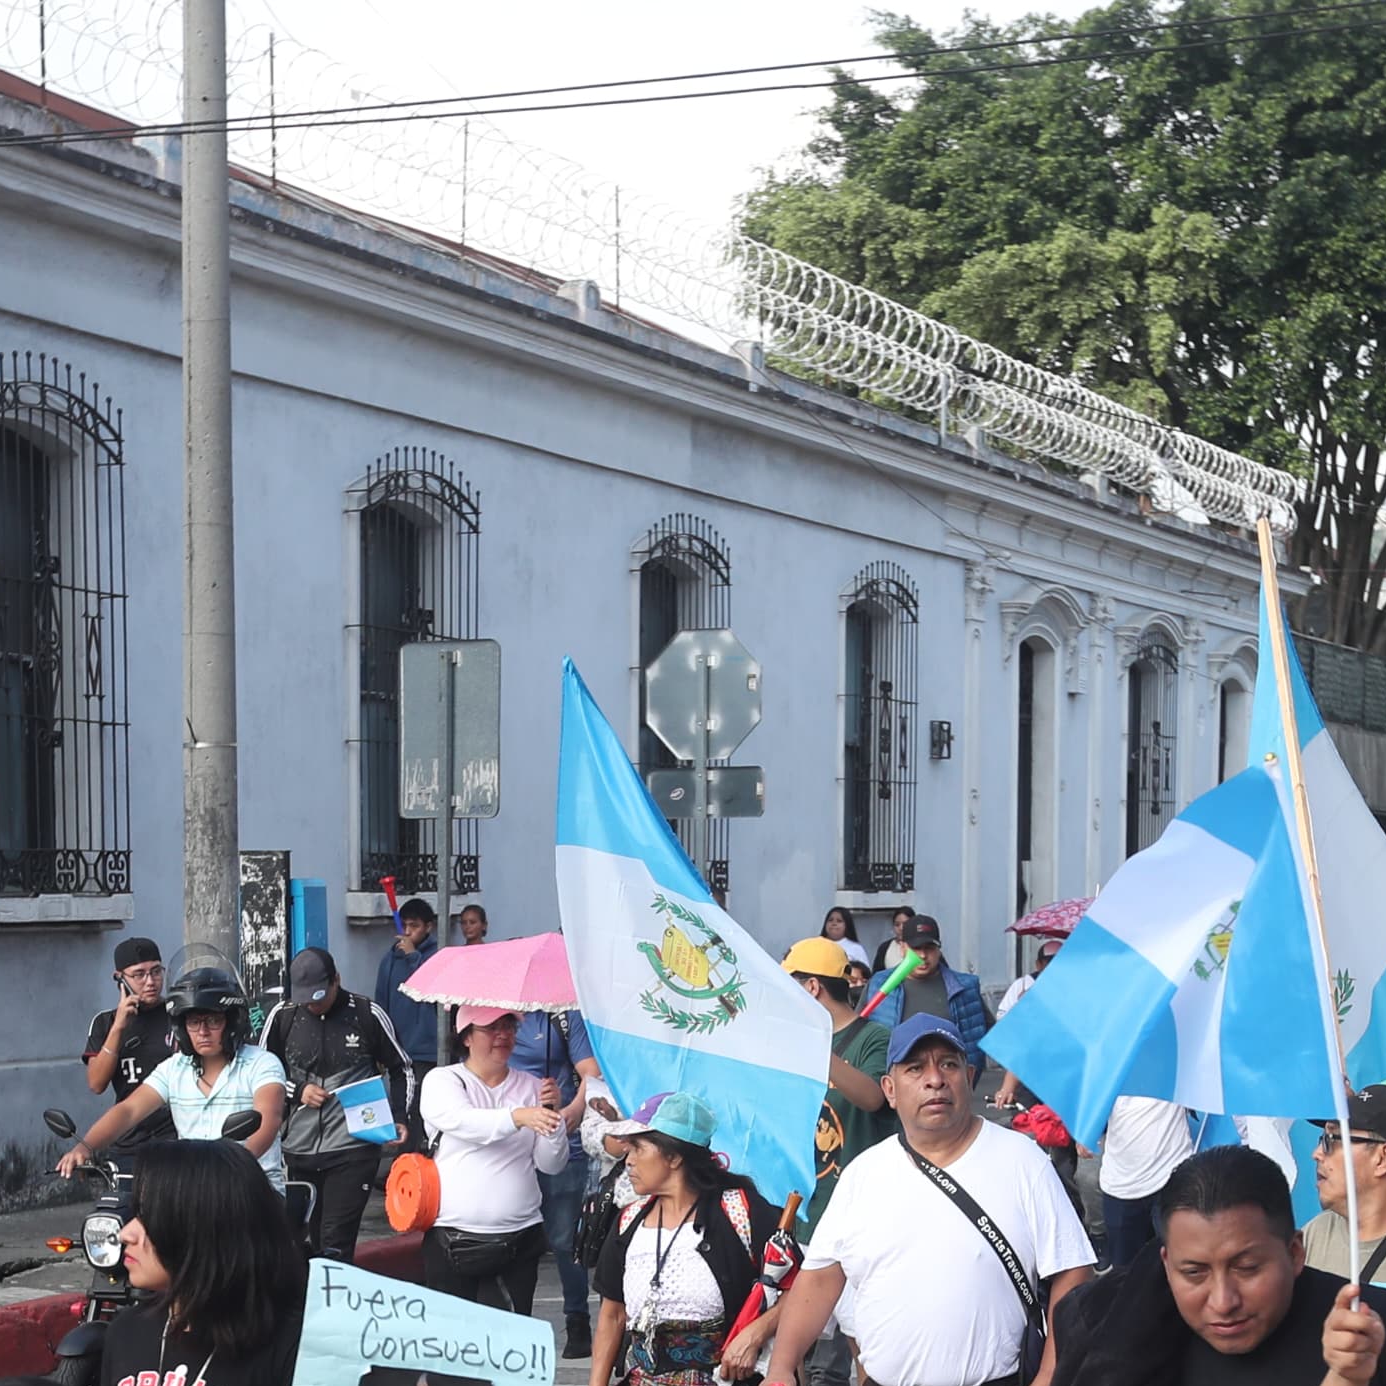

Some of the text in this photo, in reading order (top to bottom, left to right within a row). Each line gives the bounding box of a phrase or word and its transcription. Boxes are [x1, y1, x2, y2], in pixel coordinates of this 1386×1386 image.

[977, 1215, 1033, 1305] SportsTravel.com
[321, 1264, 426, 1323] Fuera
[360, 1316, 547, 1381] Consuelo!!
